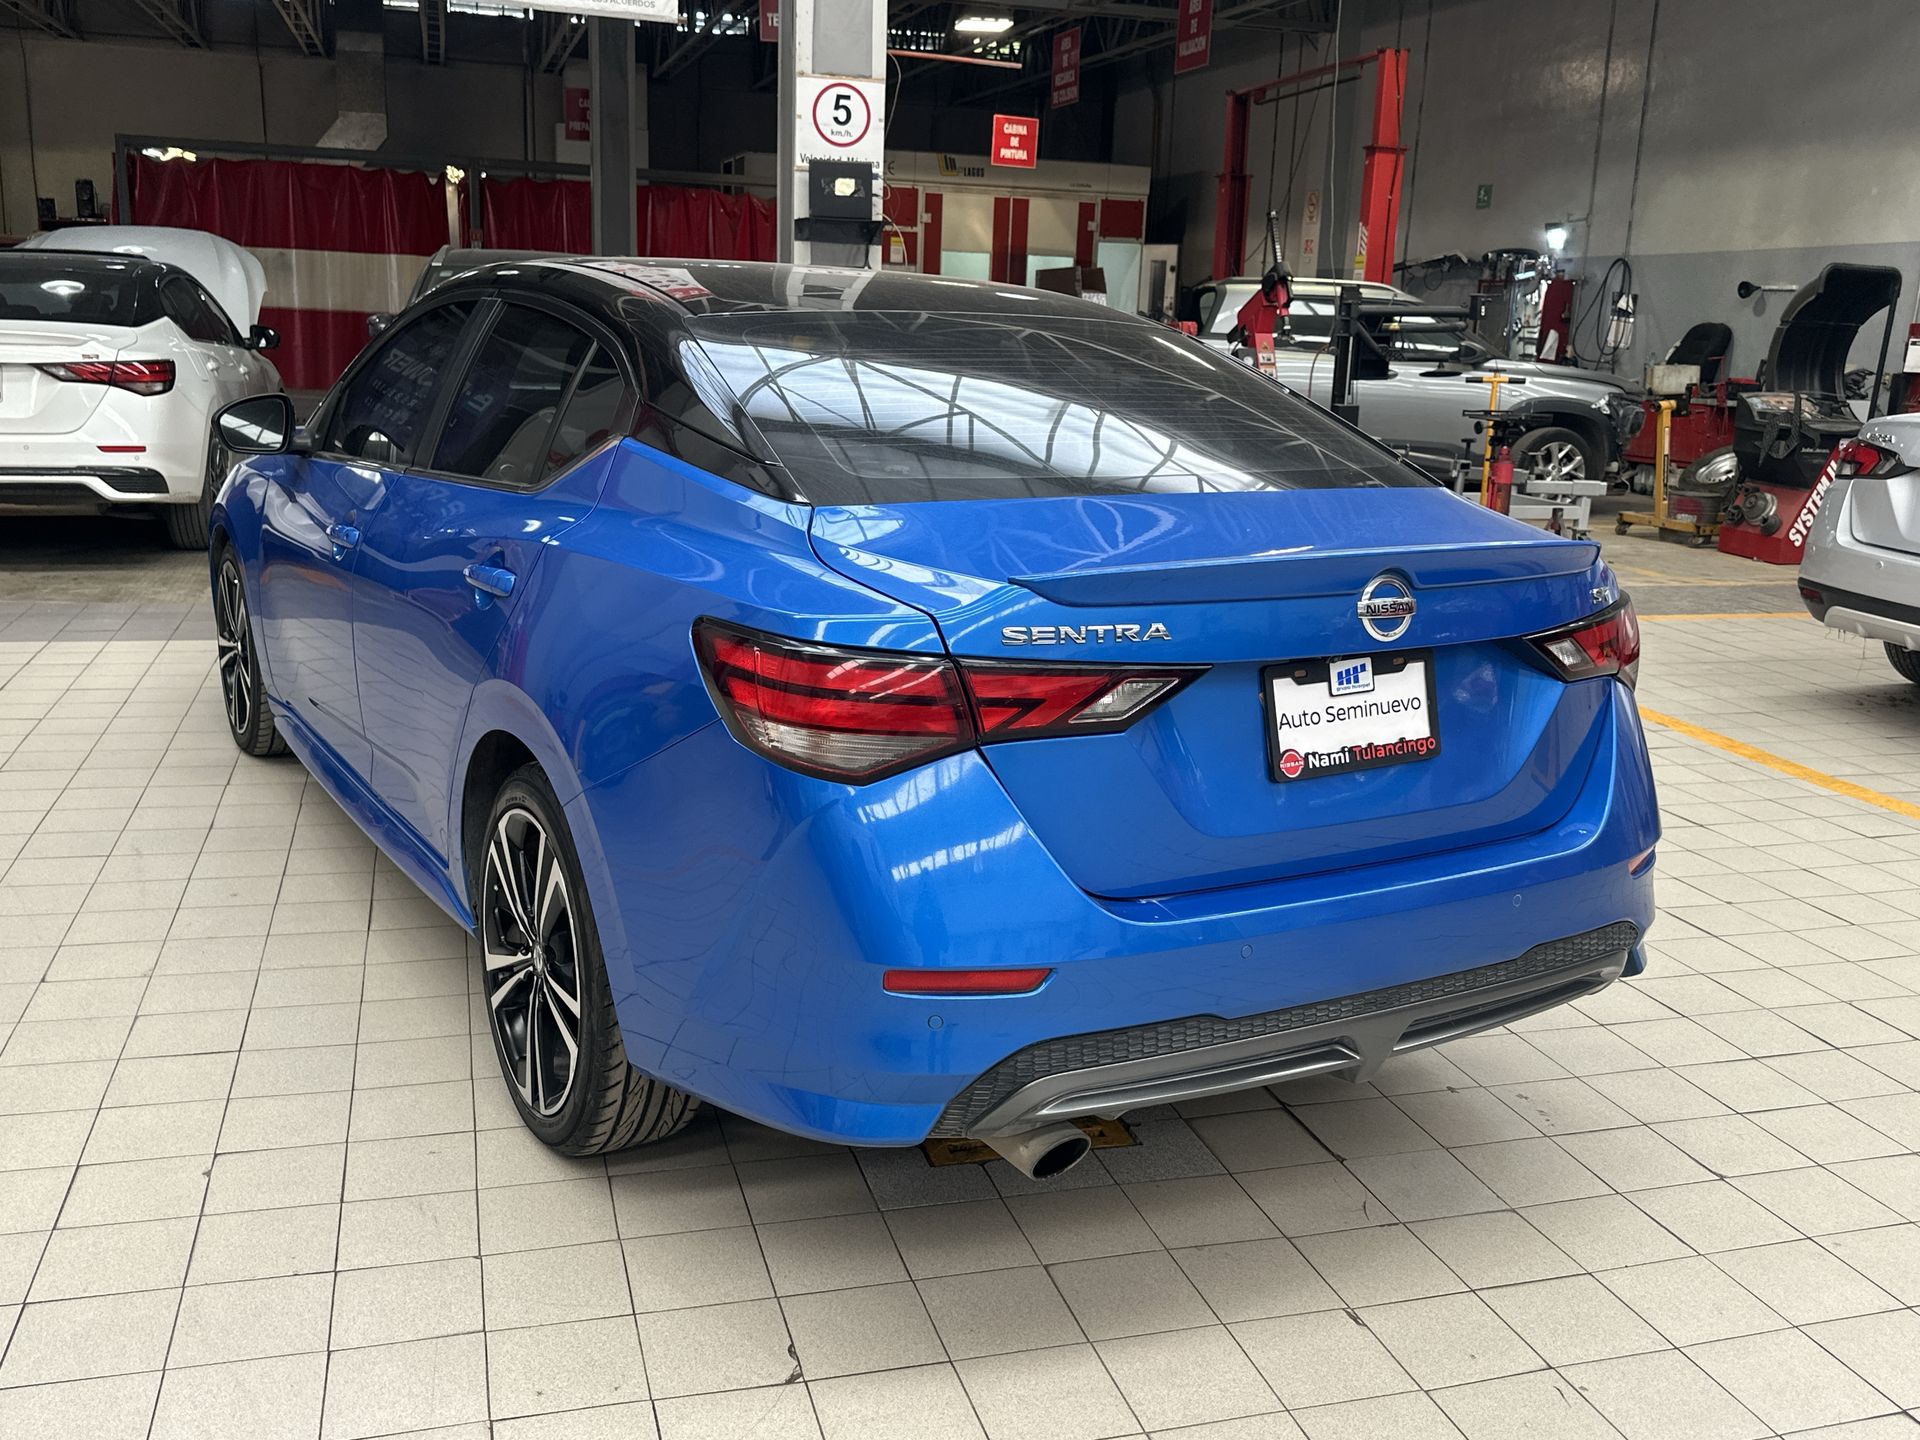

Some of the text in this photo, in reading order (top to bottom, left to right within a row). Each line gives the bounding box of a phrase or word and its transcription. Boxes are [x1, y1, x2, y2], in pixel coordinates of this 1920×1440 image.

[832, 94, 852, 126] 5
[1000, 148, 1027, 160] PINTURA
[1010, 137, 1019, 147] DE
[1788, 475, 1830, 547] SYSTEM
[1366, 602, 1414, 614] NISSAN
[1001, 622, 1172, 645] SENTRA
[1279, 696, 1421, 730] Auto Seminuevo
[1308, 737, 1436, 769] Nami Tulancingo
